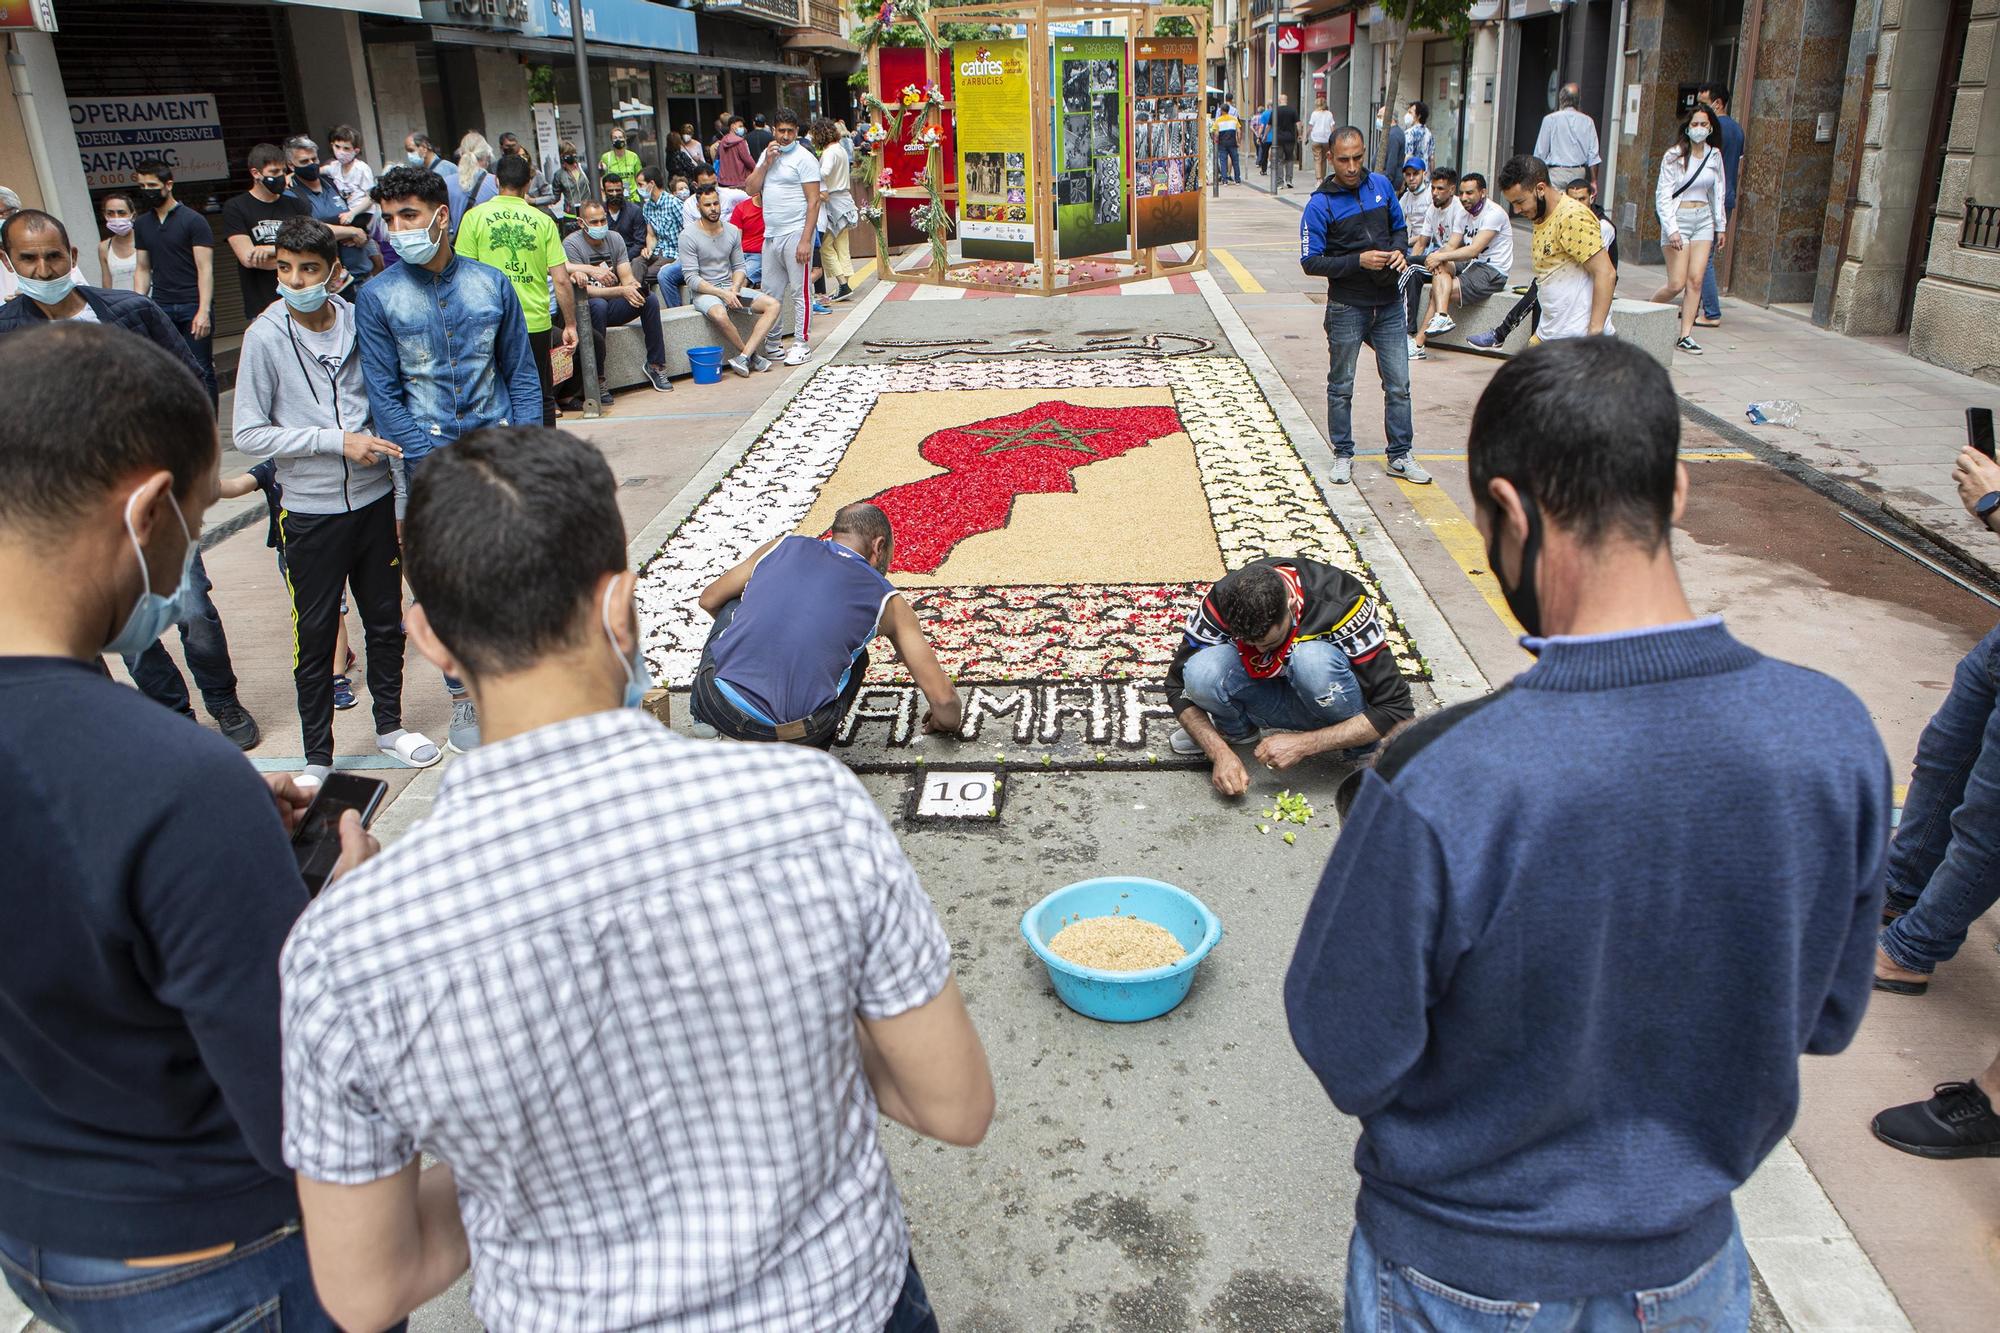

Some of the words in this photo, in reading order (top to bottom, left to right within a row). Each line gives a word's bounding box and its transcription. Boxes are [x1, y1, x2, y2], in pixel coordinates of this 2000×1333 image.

[1084, 43, 1118, 54] 1960-1969
[1163, 43, 1193, 54] 1970-1979
[70, 100, 209, 124] OPERAMENT
[136, 127, 215, 143] AUTOSERVEI
[101, 174, 125, 184] 000
[486, 211, 538, 230] ARGANA
[930, 781, 988, 801] 10
